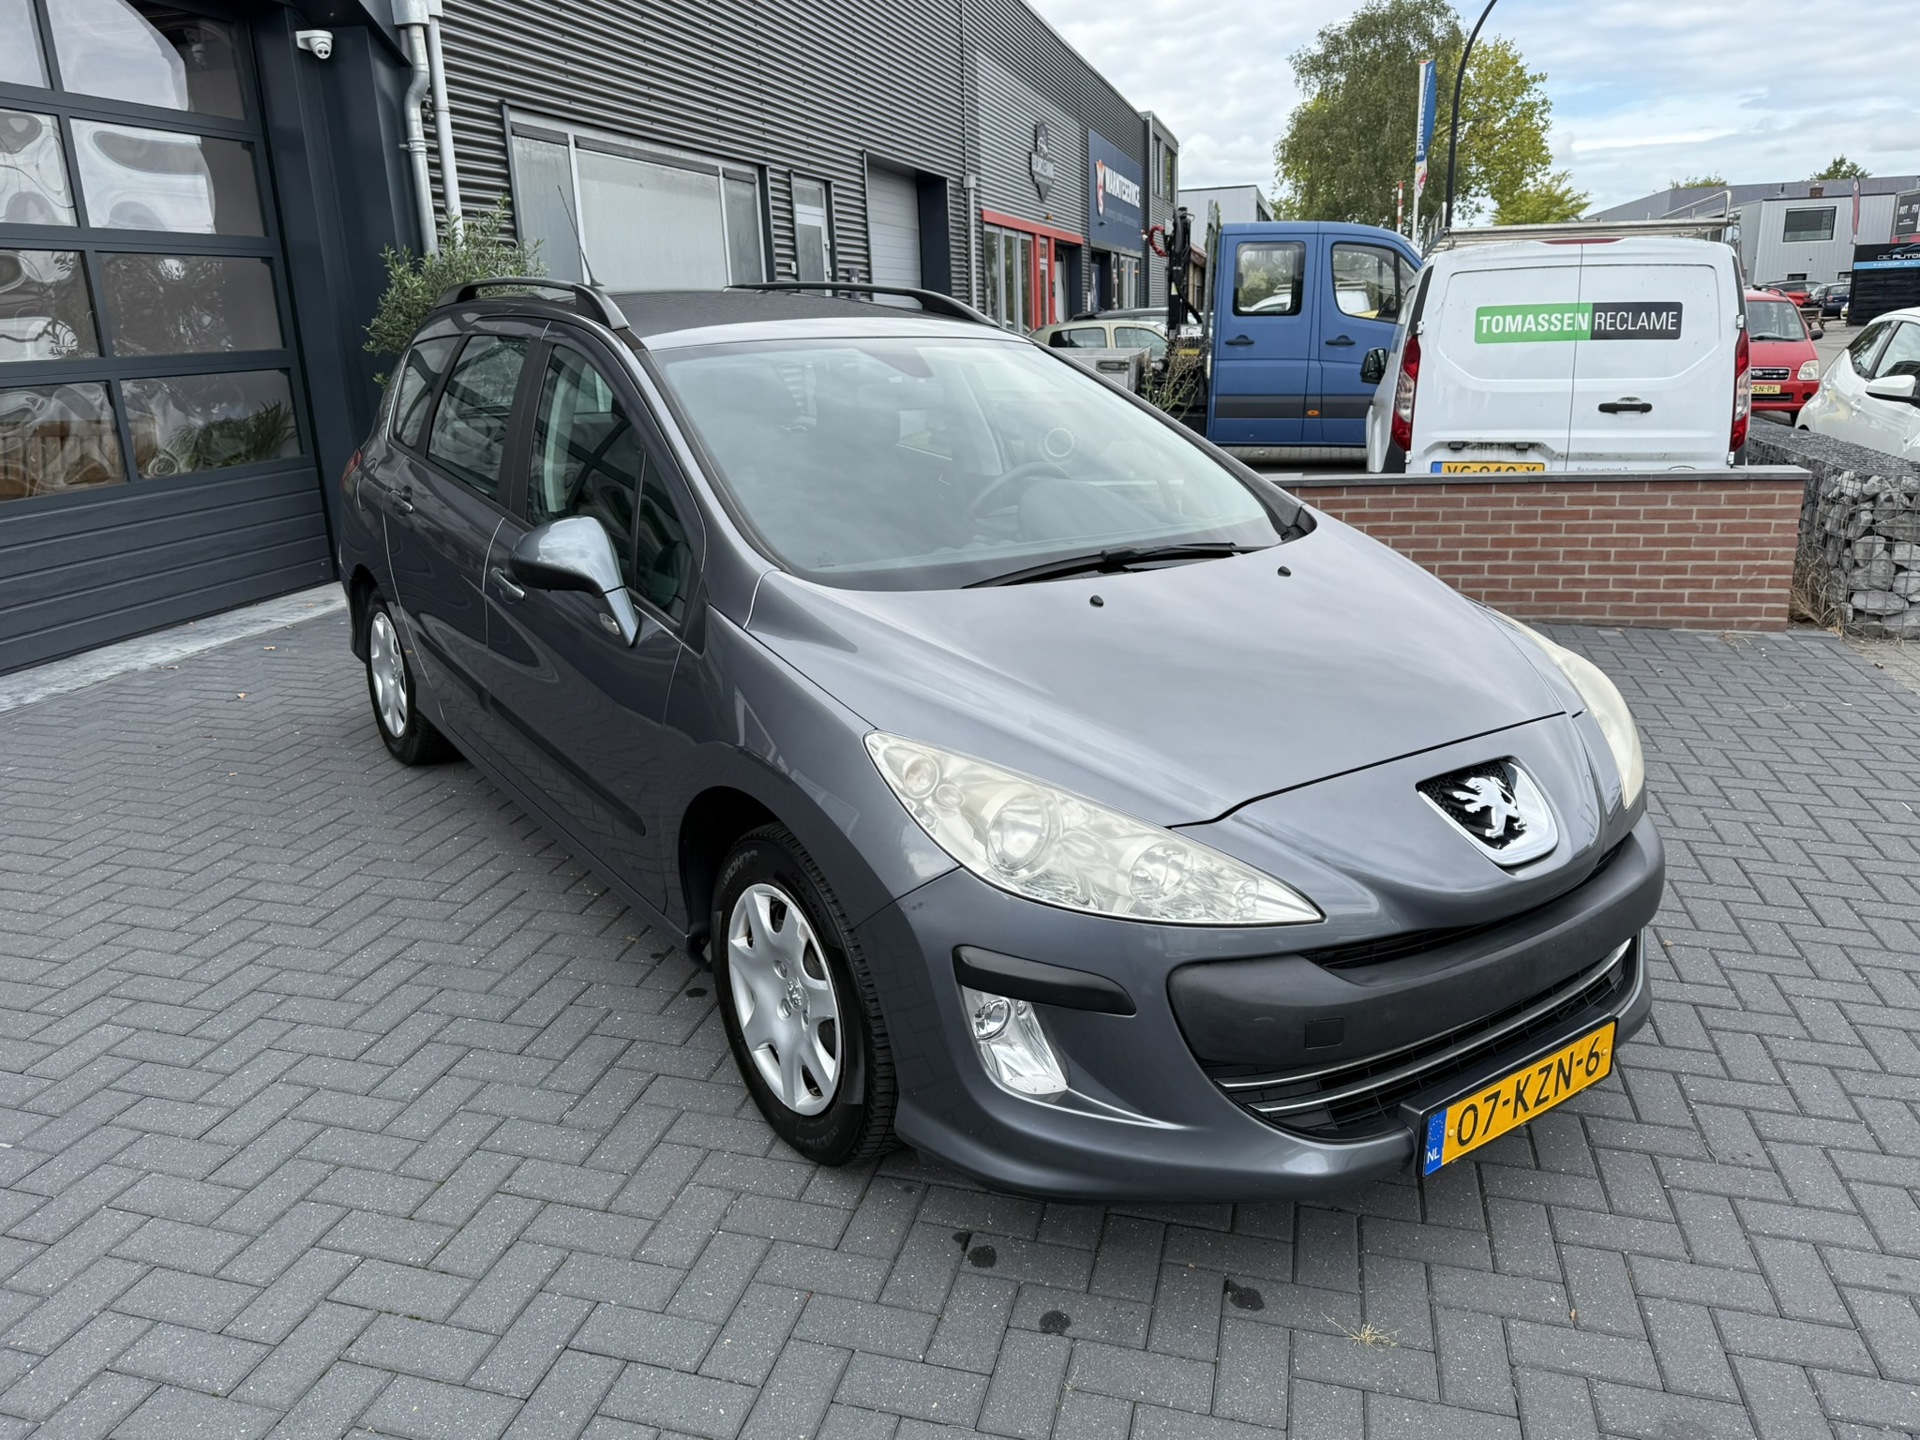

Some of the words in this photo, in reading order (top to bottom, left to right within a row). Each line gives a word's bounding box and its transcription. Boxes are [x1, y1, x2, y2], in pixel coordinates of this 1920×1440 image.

[1479, 312, 1589, 334] TOMASSEN
[1594, 311, 1677, 331] RECLAME
[1456, 1036, 1600, 1147] 07-KZN-6
[1427, 1147, 1440, 1163] NL
